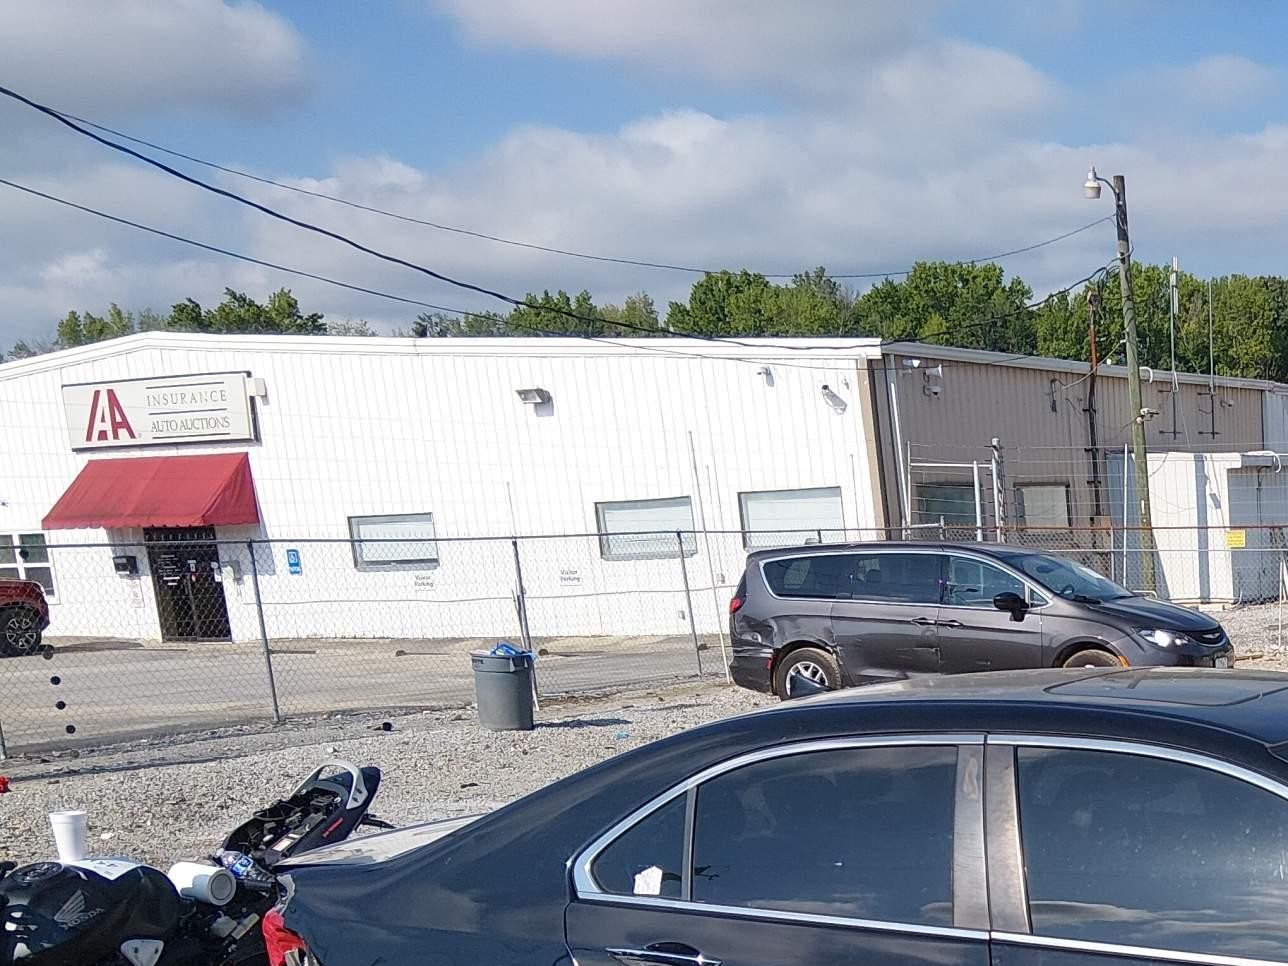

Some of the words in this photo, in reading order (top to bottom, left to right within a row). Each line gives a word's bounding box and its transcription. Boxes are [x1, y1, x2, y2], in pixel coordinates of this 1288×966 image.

[146, 389, 228, 407] INSURANCE
[150, 418, 178, 433] AUTO
[179, 415, 231, 431] AUCTIONS
